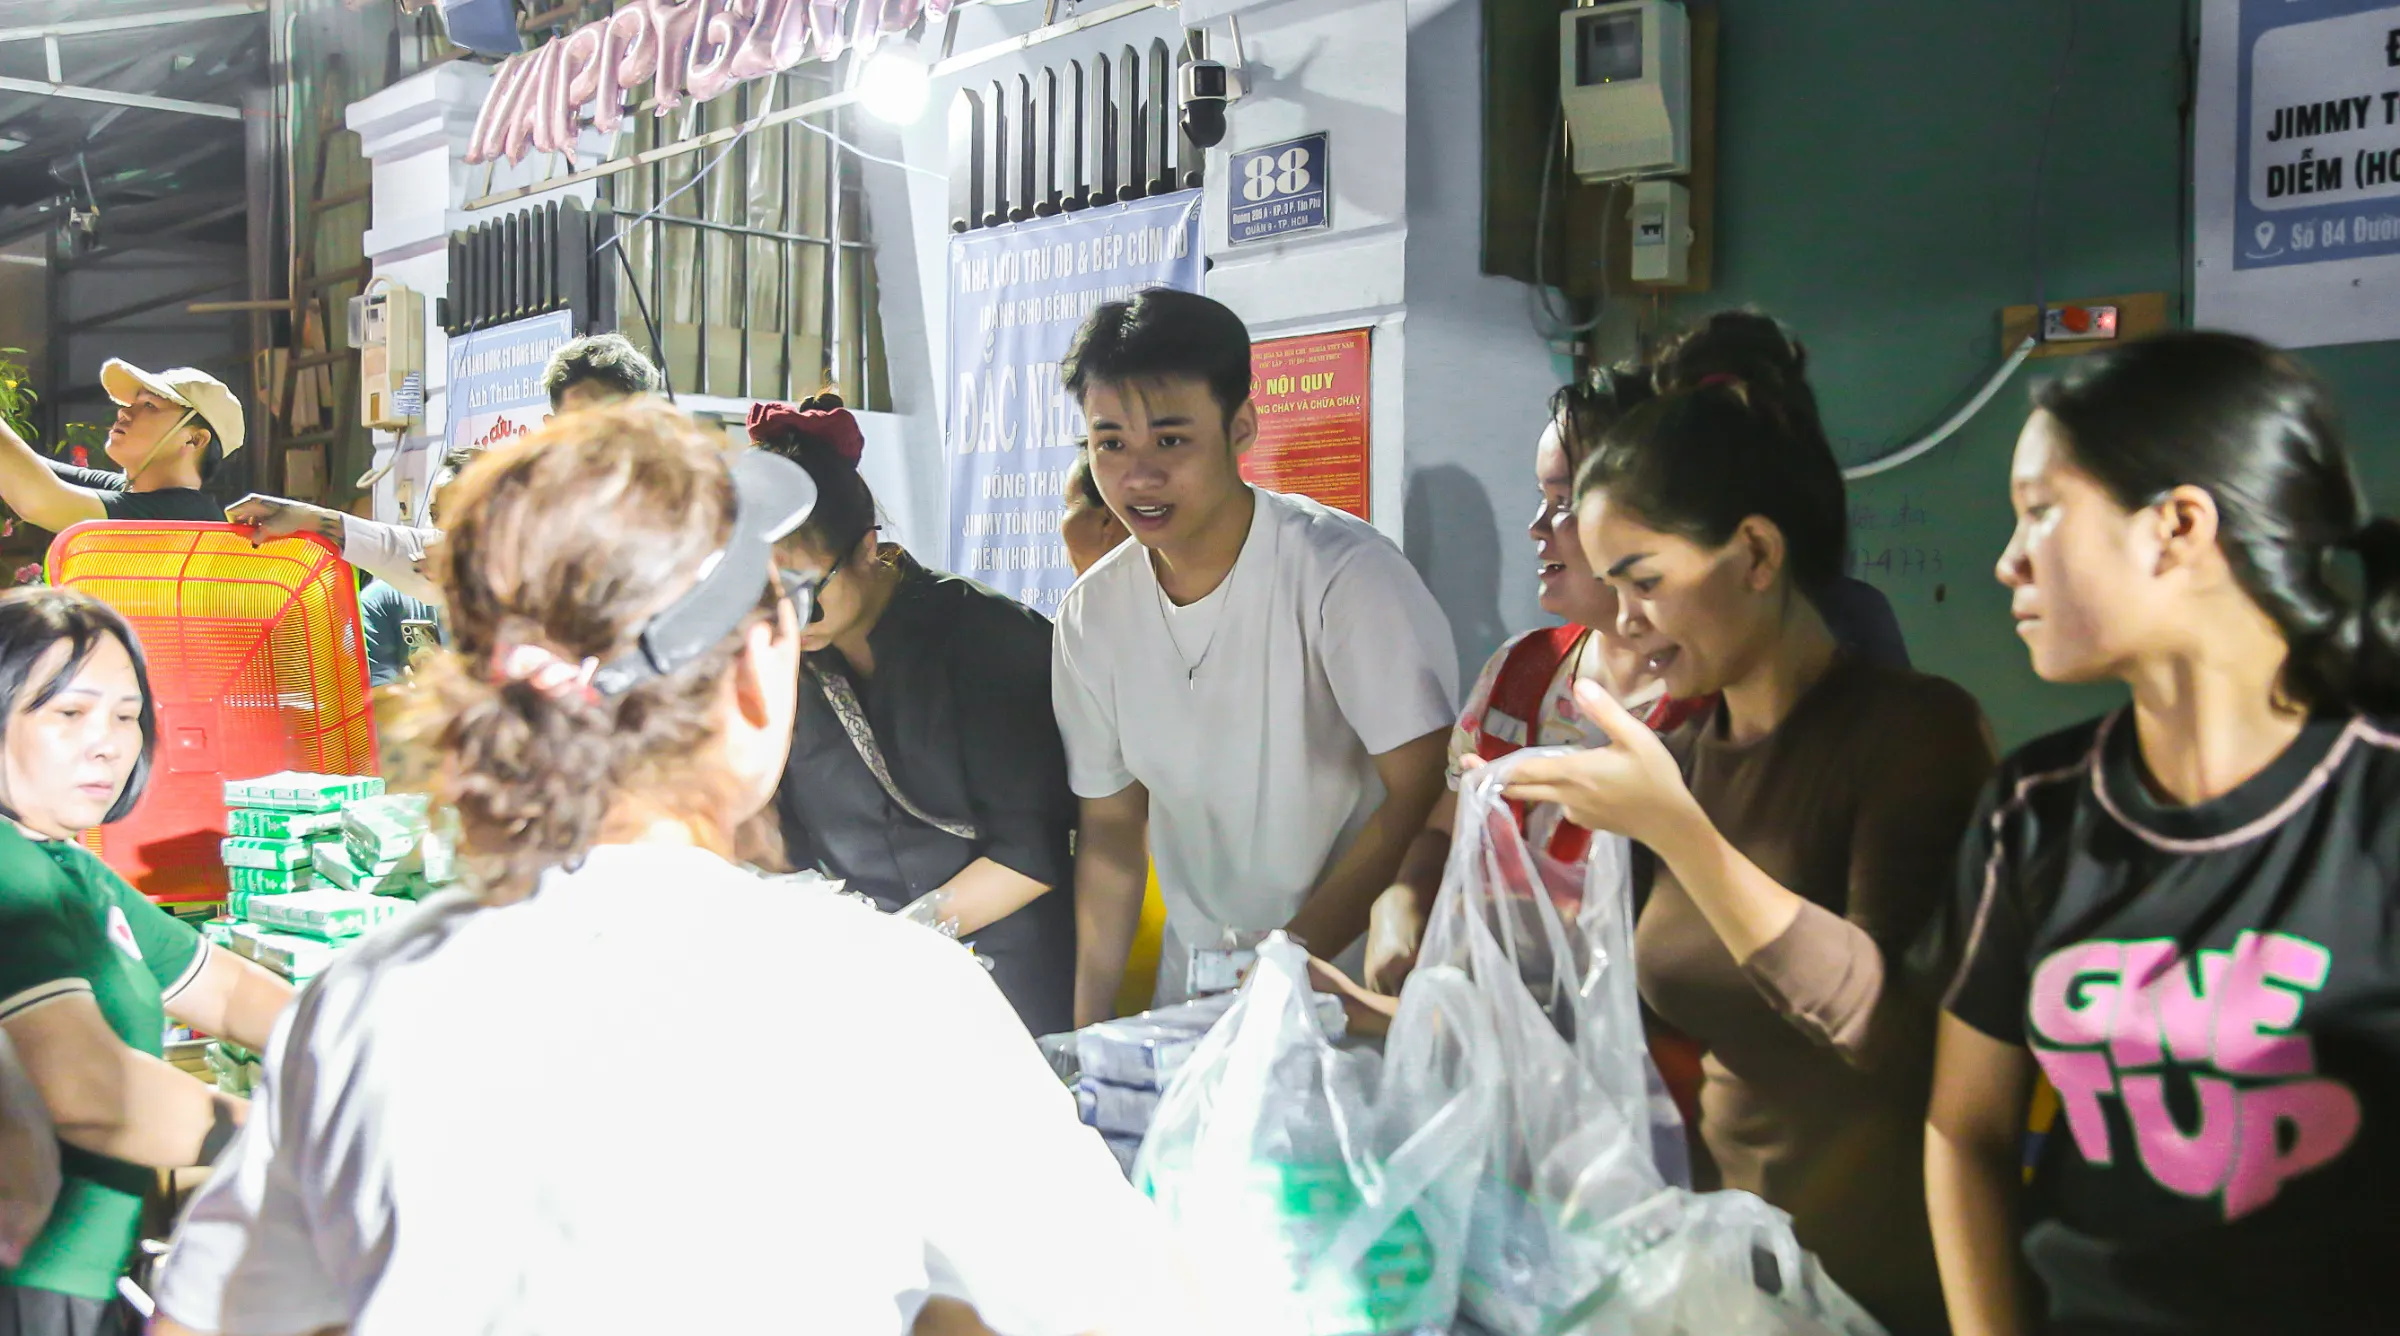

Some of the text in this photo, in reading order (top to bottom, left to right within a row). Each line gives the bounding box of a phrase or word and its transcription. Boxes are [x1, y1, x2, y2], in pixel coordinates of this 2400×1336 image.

[2267, 95, 2371, 142] JIMMY
[1243, 147, 1310, 202] 88
[1291, 215, 1309, 227] HCM
[2321, 217, 2346, 248] 84
[1078, 240, 1088, 275] &
[1093, 224, 1123, 272] BẾP
[1127, 225, 1163, 266] CƠM
[1019, 297, 1042, 325] CHO
[1045, 290, 1078, 326] BỆNH
[490, 378, 521, 404] Thanh
[1266, 374, 1296, 398] NỘI
[1301, 372, 1335, 394] QUY
[1272, 400, 1295, 413] CHÁY
[1297, 399, 1309, 410] VÀ
[962, 512, 1002, 537] JIMMY
[1005, 507, 1030, 535] TÔN
